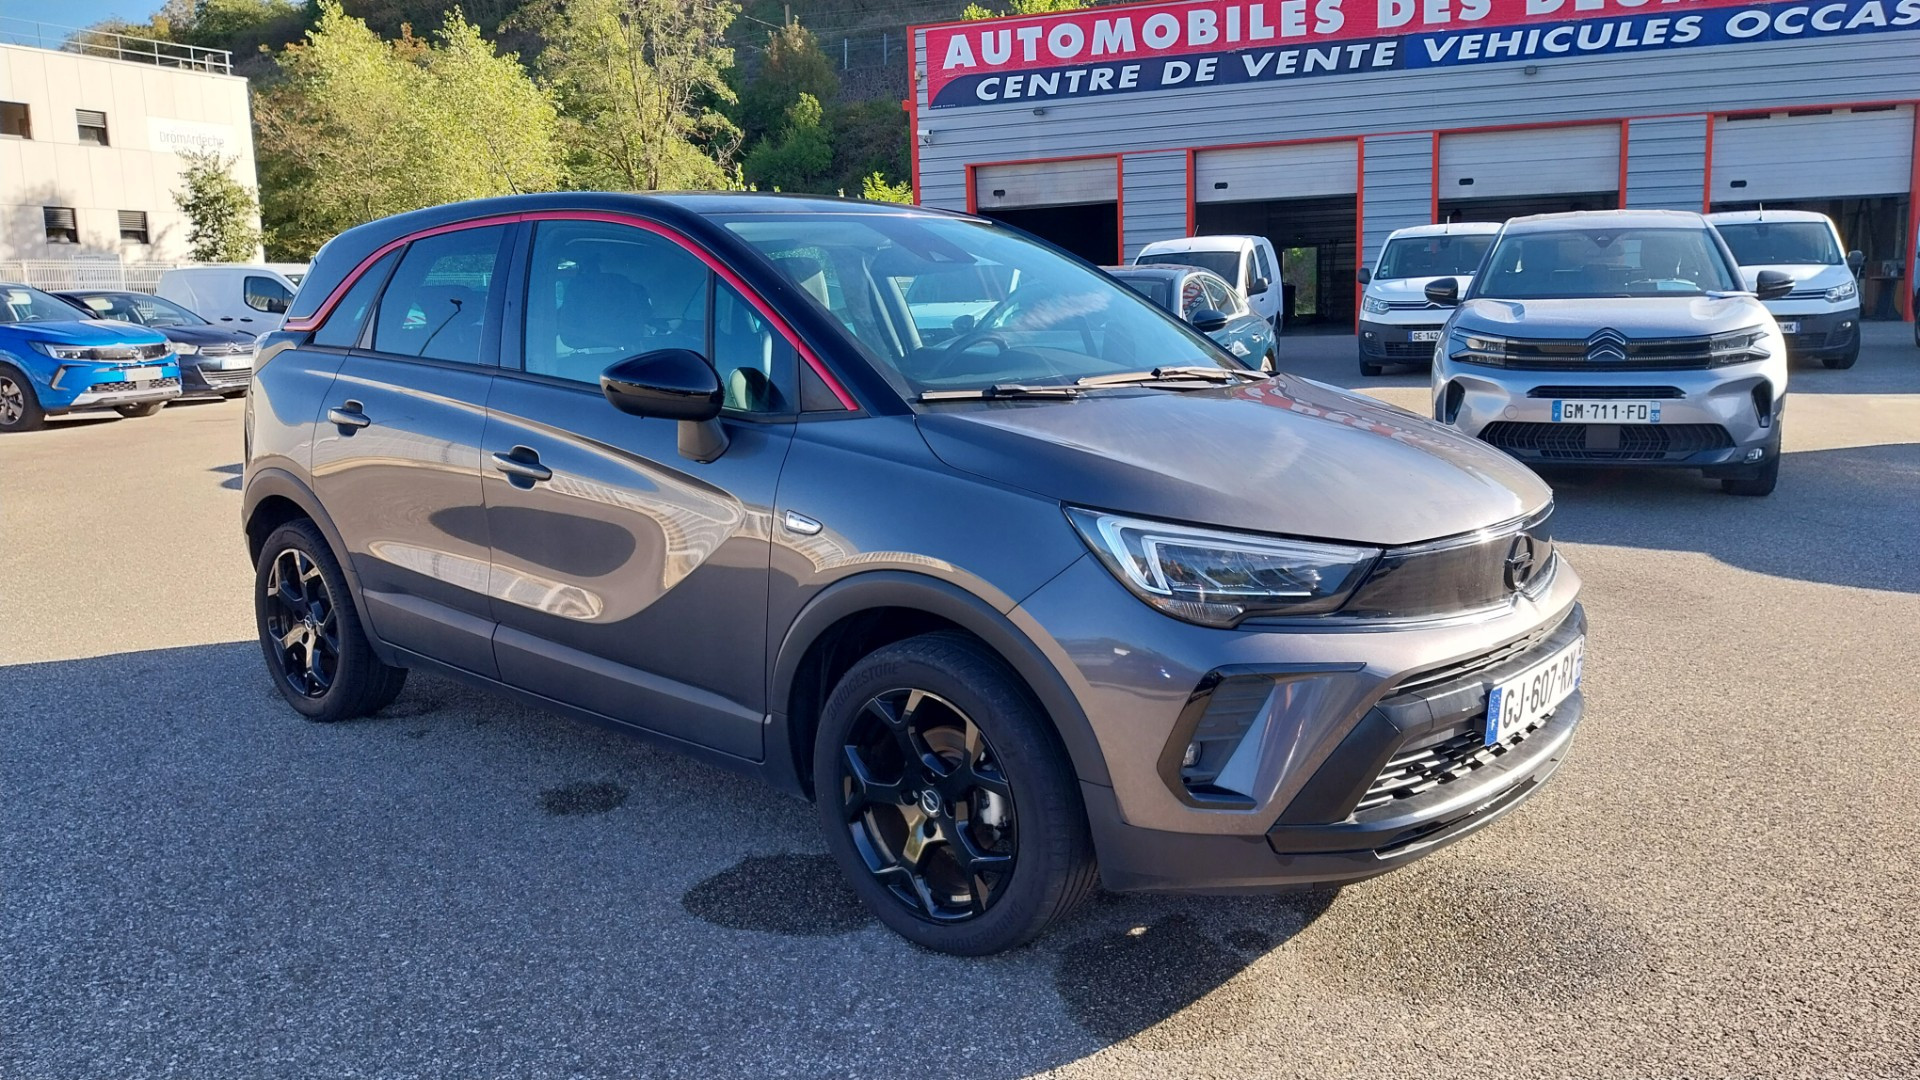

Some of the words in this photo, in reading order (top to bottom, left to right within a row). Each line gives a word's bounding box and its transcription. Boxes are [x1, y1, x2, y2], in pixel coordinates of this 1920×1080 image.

[943, 0, 1344, 69] AUTOMOBILES
[976, 65, 1140, 100] CENTRE
[1161, 57, 1218, 86] DE
[1242, 41, 1398, 77] VENTE
[1423, 15, 1703, 62] VEHICULES
[1726, 0, 1920, 38] OCCAS
[1564, 404, 1647, 420] GM-711-FD
[1502, 648, 1577, 729] GJ-607-RX
